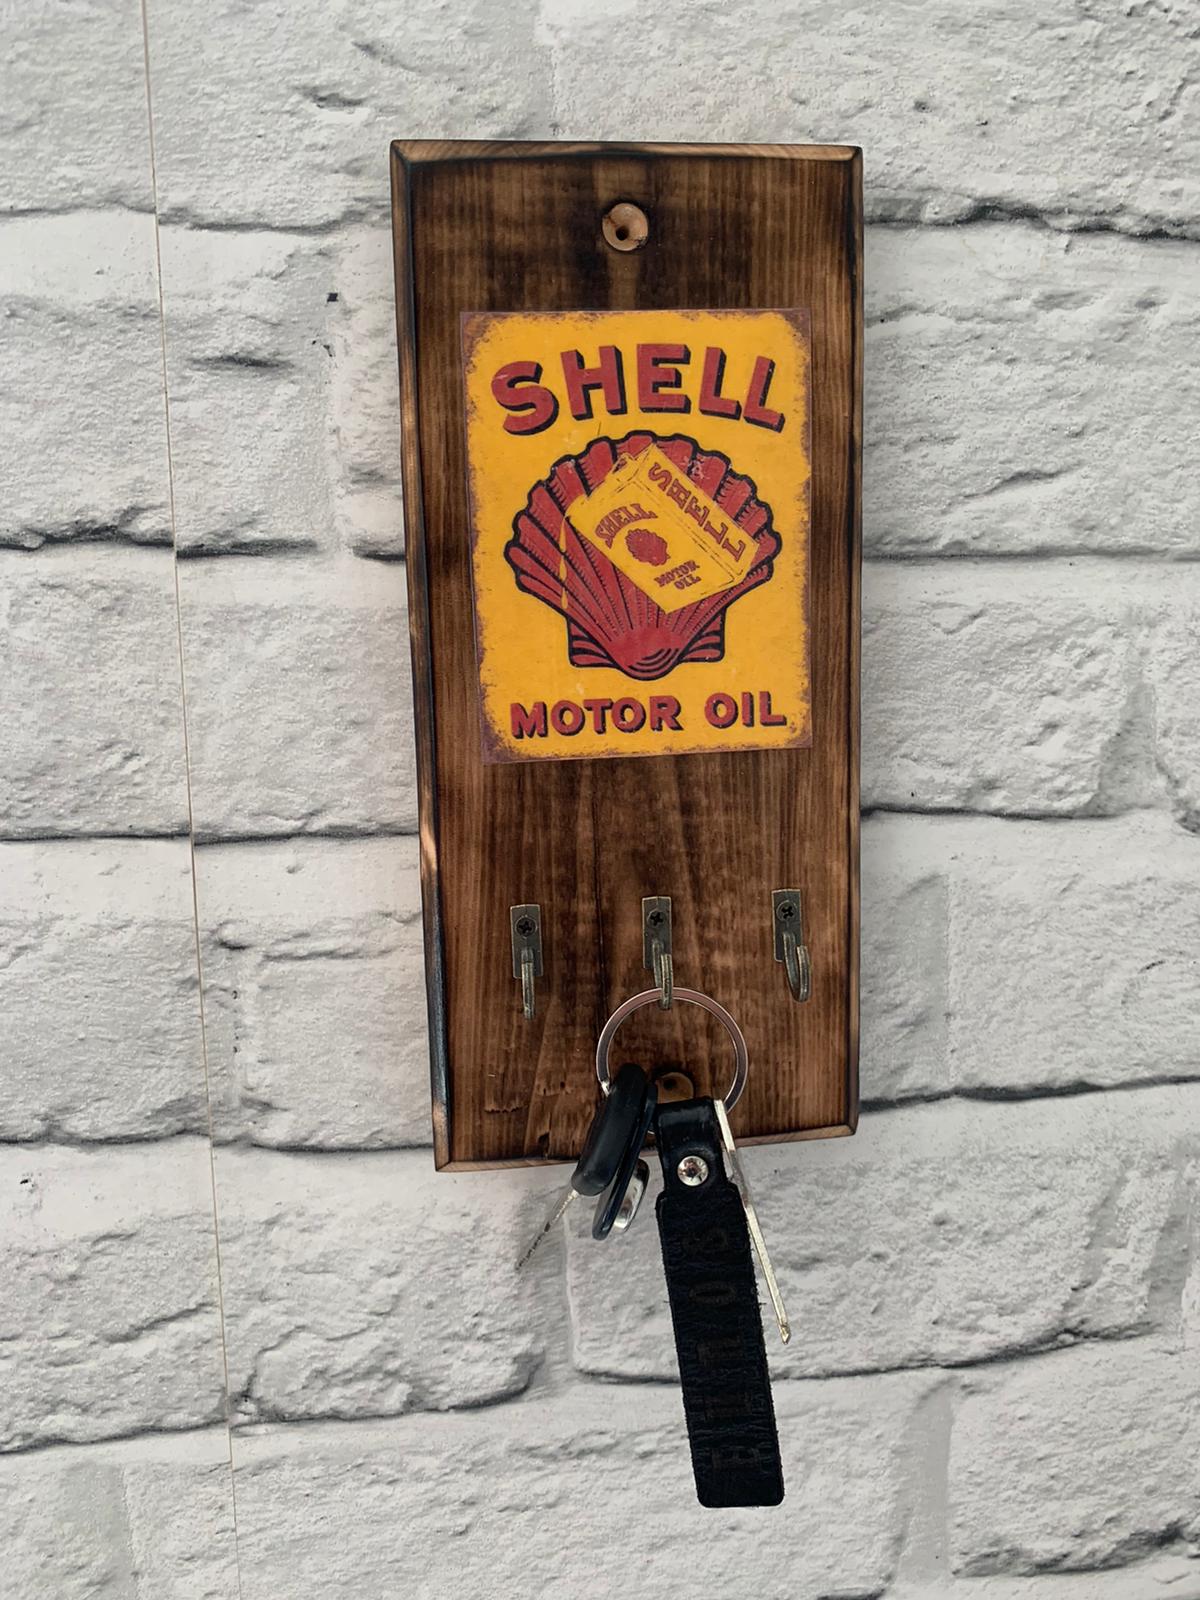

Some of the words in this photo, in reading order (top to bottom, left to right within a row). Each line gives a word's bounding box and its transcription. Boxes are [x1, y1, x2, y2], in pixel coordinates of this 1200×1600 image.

[490, 343, 786, 436] SHELL
[594, 503, 659, 550] SHELL
[647, 461, 748, 563] SHELL
[654, 559, 701, 588] MOTOR
[674, 574, 702, 591] OIL
[510, 694, 684, 740] MOTOR
[704, 690, 788, 730] OIL
